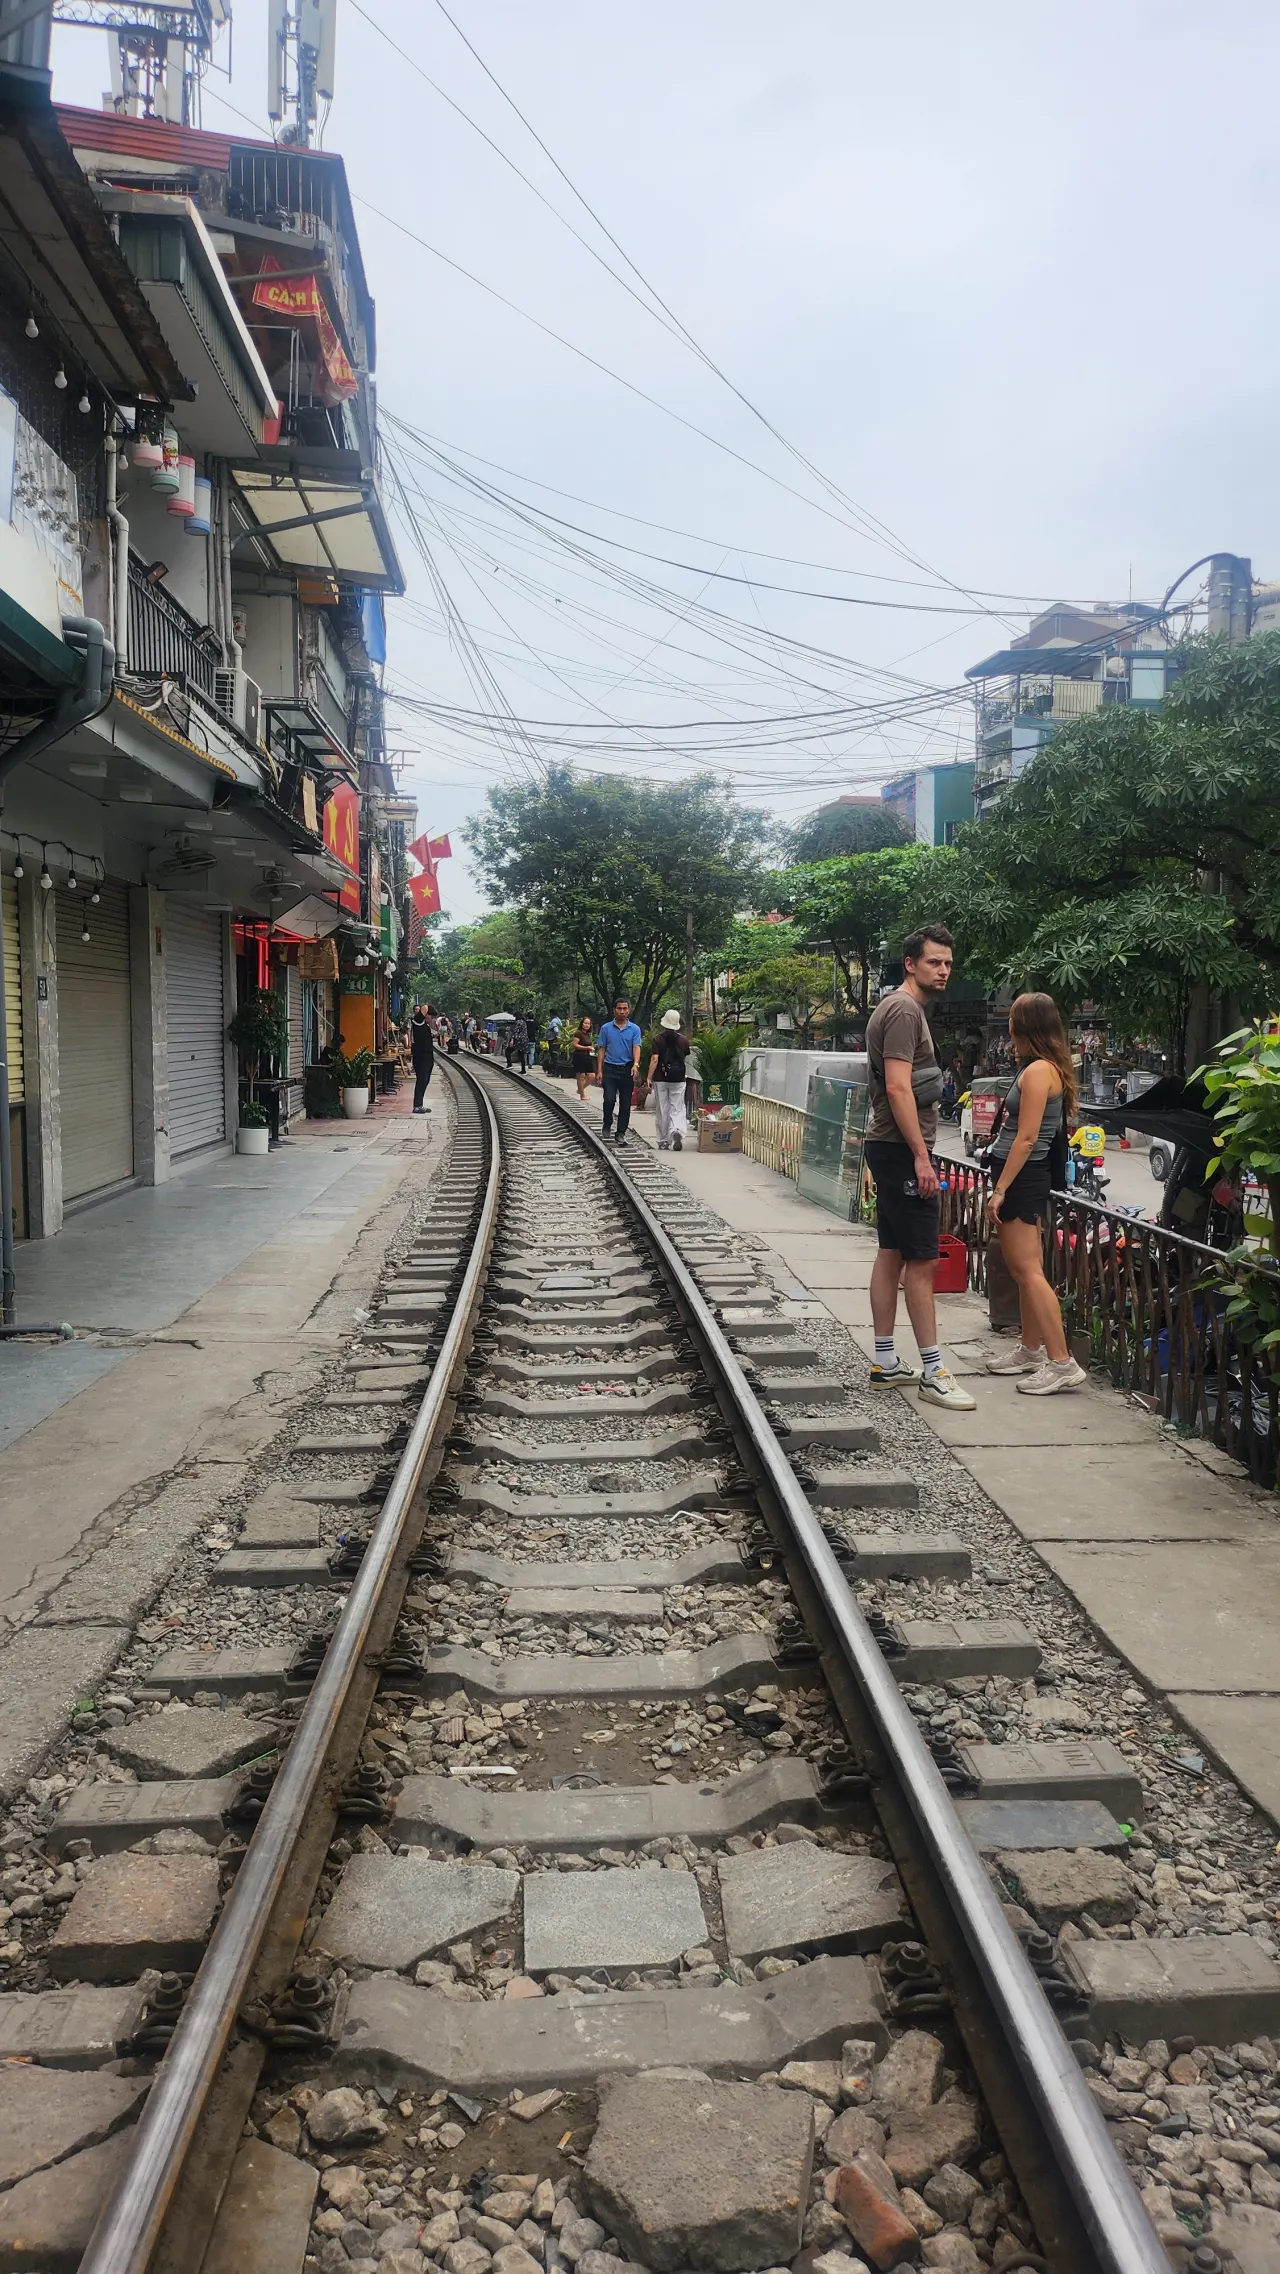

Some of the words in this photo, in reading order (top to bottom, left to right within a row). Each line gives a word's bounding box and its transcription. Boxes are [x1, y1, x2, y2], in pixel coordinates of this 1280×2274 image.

[346, 979, 367, 990] 40
[713, 1131, 732, 1140] Surf
[1085, 1129, 1100, 1141] be
